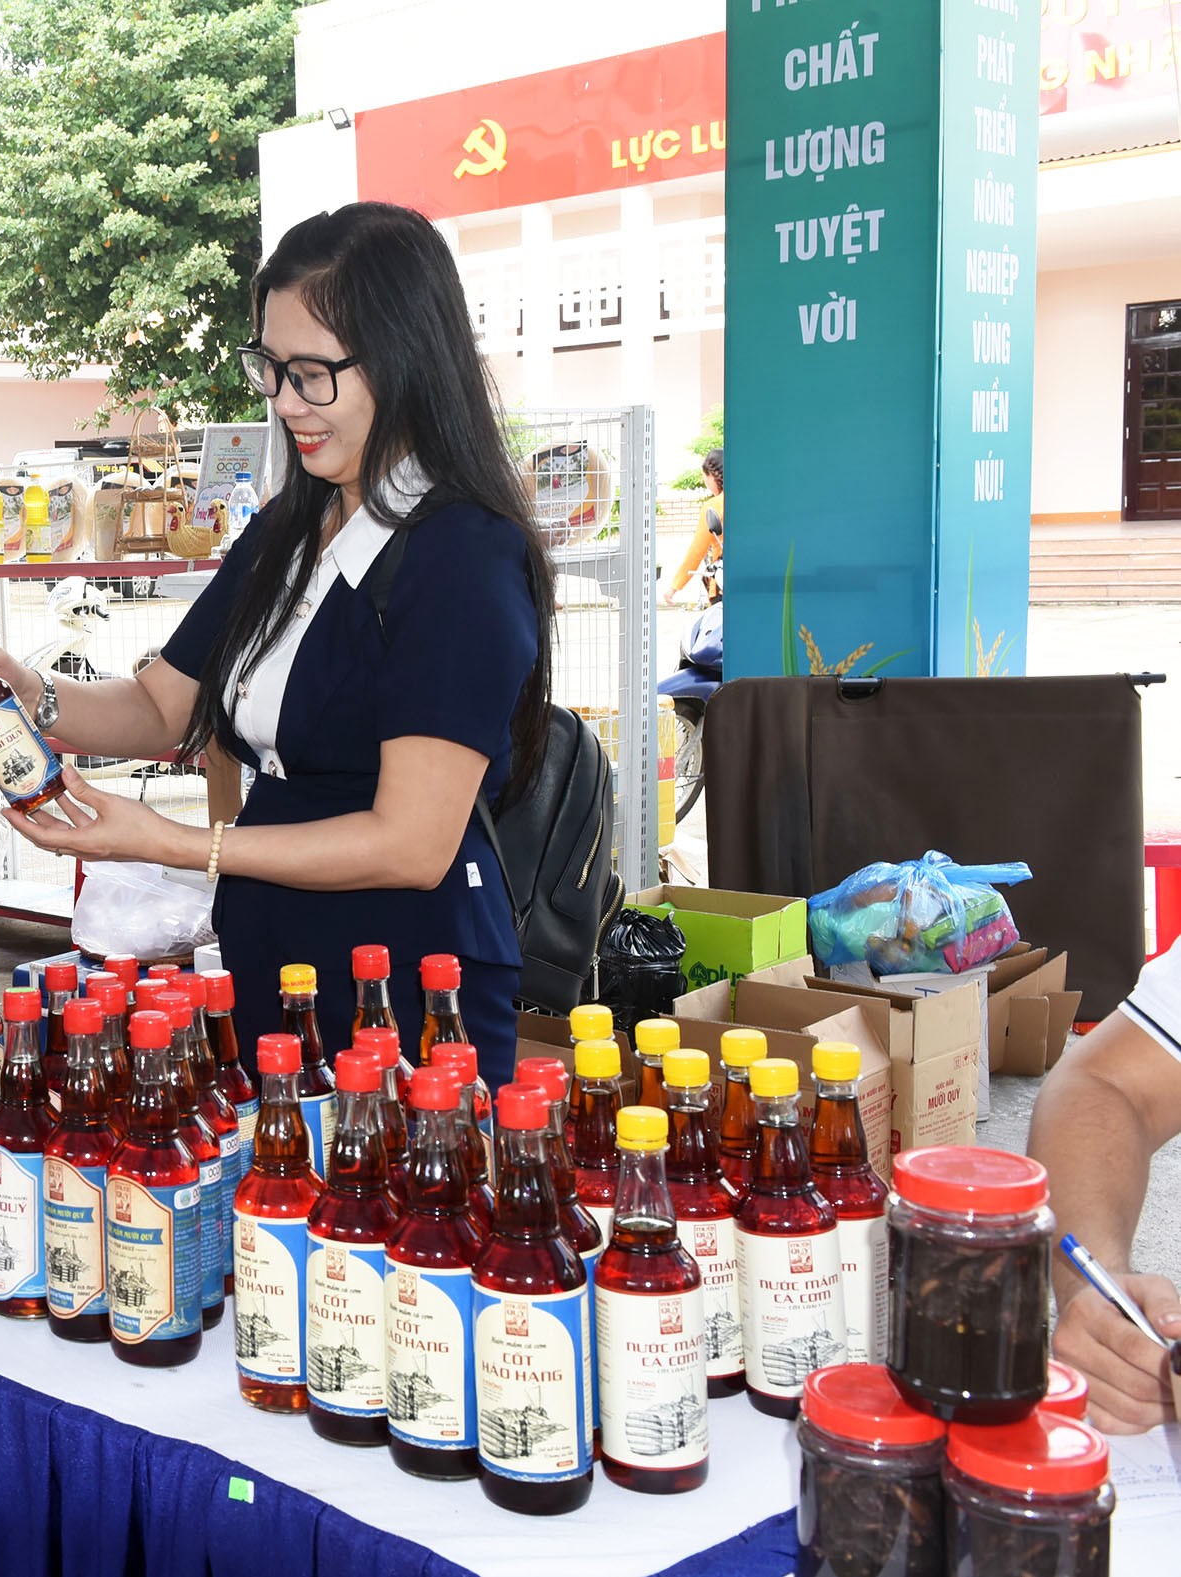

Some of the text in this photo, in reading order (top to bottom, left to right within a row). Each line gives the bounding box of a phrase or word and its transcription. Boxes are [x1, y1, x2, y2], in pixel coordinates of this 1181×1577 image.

[784, 21, 879, 90] CHẤT
[977, 31, 1015, 86] PHÁT
[611, 128, 682, 172] LỰC
[765, 121, 885, 182] LƯỢNG
[974, 94, 1016, 157] TRIỂN
[974, 171, 1014, 226] NÔNG
[775, 204, 885, 265] TUYỆT
[966, 244, 1019, 305] NGHIỆP
[798, 291, 856, 345] VỜI
[972, 311, 1010, 364] VÙNG
[972, 376, 1009, 432] MIỀN
[216, 462, 249, 472] OCOP
[974, 451, 1004, 502] NÚI!
[760, 1273, 839, 1291] NƯỚC MẮM
